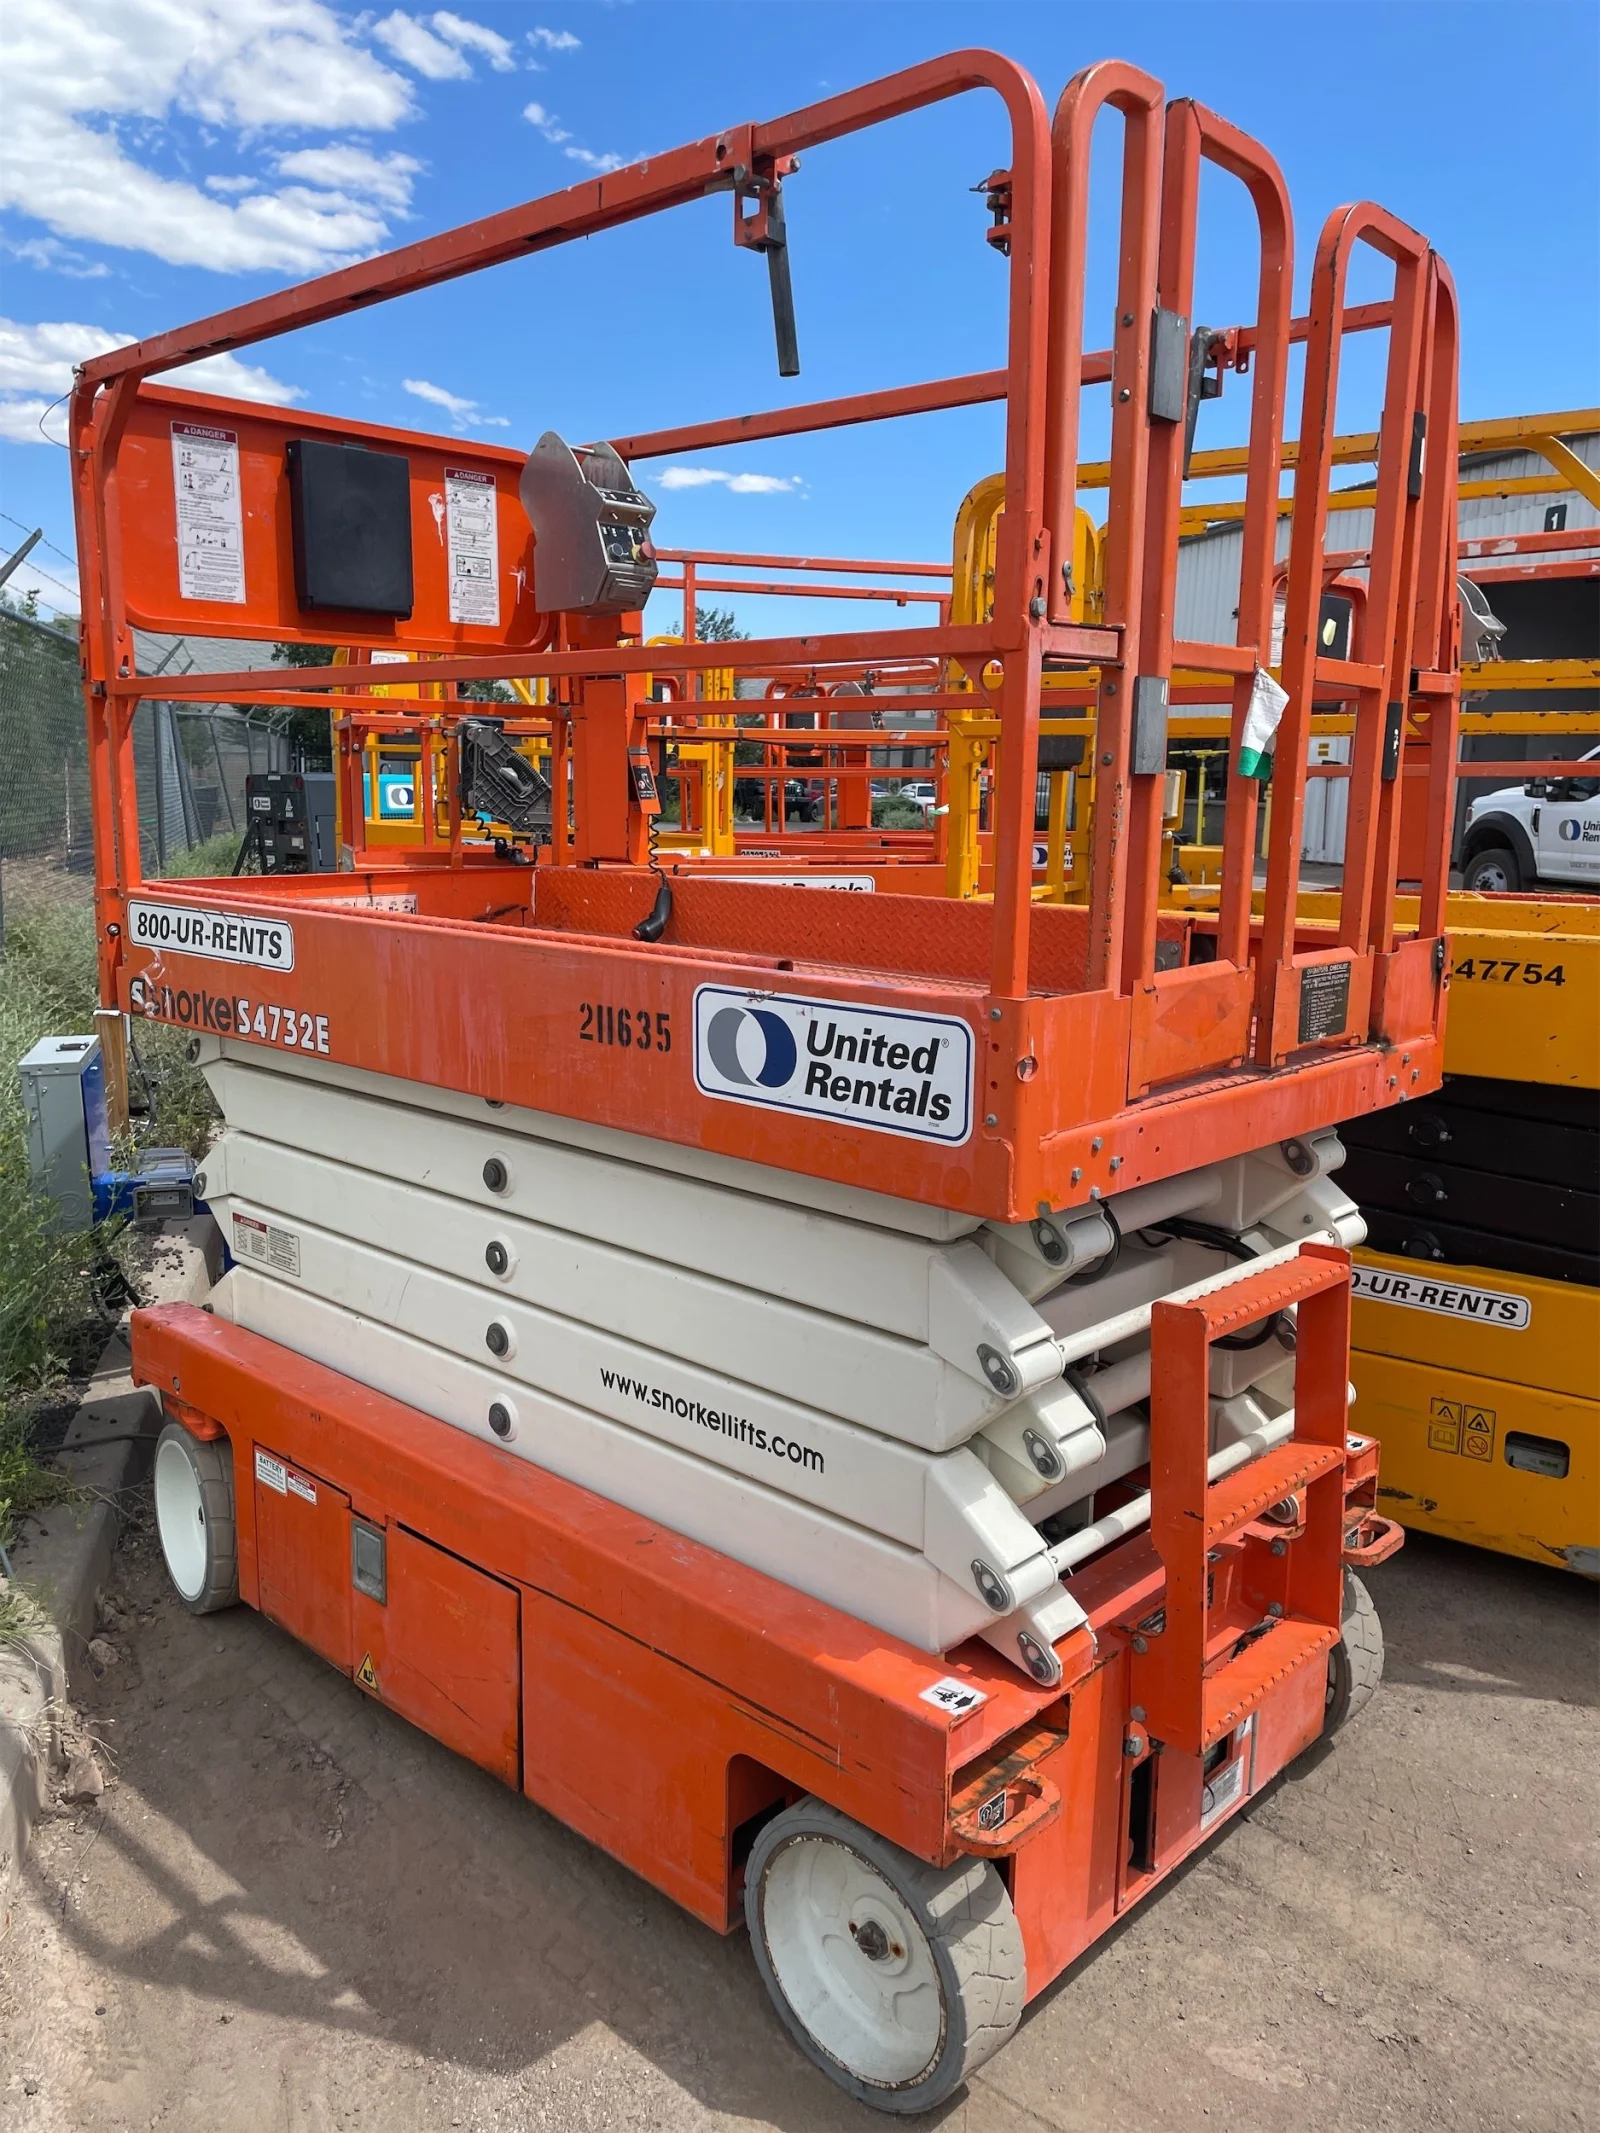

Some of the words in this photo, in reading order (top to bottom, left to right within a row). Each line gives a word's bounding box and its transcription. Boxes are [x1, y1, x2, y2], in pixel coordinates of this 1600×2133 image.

[190, 427, 226, 440] DANGER
[460, 472, 487, 483] DANGER
[1551, 513, 1559, 530] 1
[138, 912, 282, 959] 800-UR-RENTS
[1451, 959, 1566, 987] 47754
[237, 998, 330, 1054] S4732E
[579, 1003, 671, 1053] 211635
[804, 1060, 952, 1122] Rentals
[600, 1367, 825, 1474] www.snorkellifts.com
[259, 1455, 283, 1474] BATTERY
